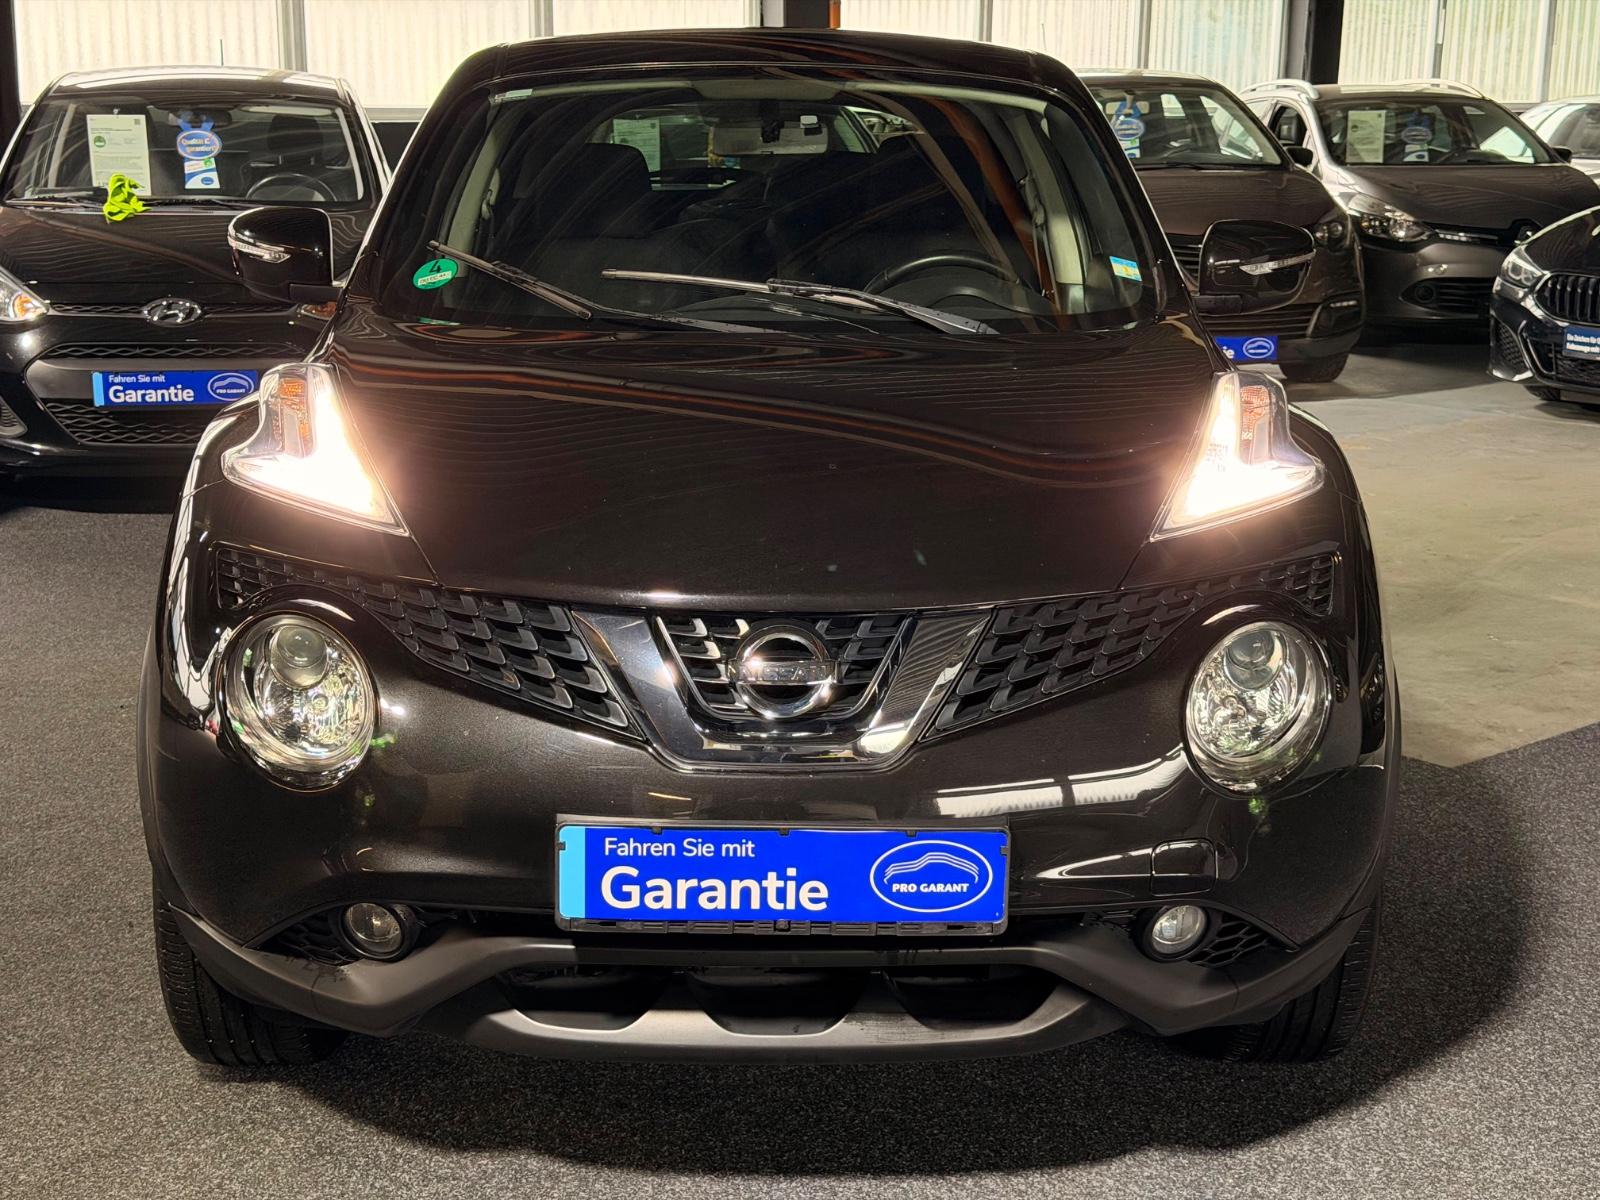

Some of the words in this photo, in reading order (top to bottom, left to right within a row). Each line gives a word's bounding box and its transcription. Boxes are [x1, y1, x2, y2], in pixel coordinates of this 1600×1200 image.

[429, 260, 442, 273] 4
[108, 374, 137, 383] Fahren
[137, 374, 150, 383] Sie
[151, 375, 166, 383] mit
[108, 385, 194, 403] Garantie
[604, 837, 676, 857] Fahren
[682, 837, 715, 857] Sie
[720, 839, 756, 858] mit
[600, 865, 829, 912] Garantie
[891, 883, 917, 893] PRO
[919, 883, 969, 893] GARANT
